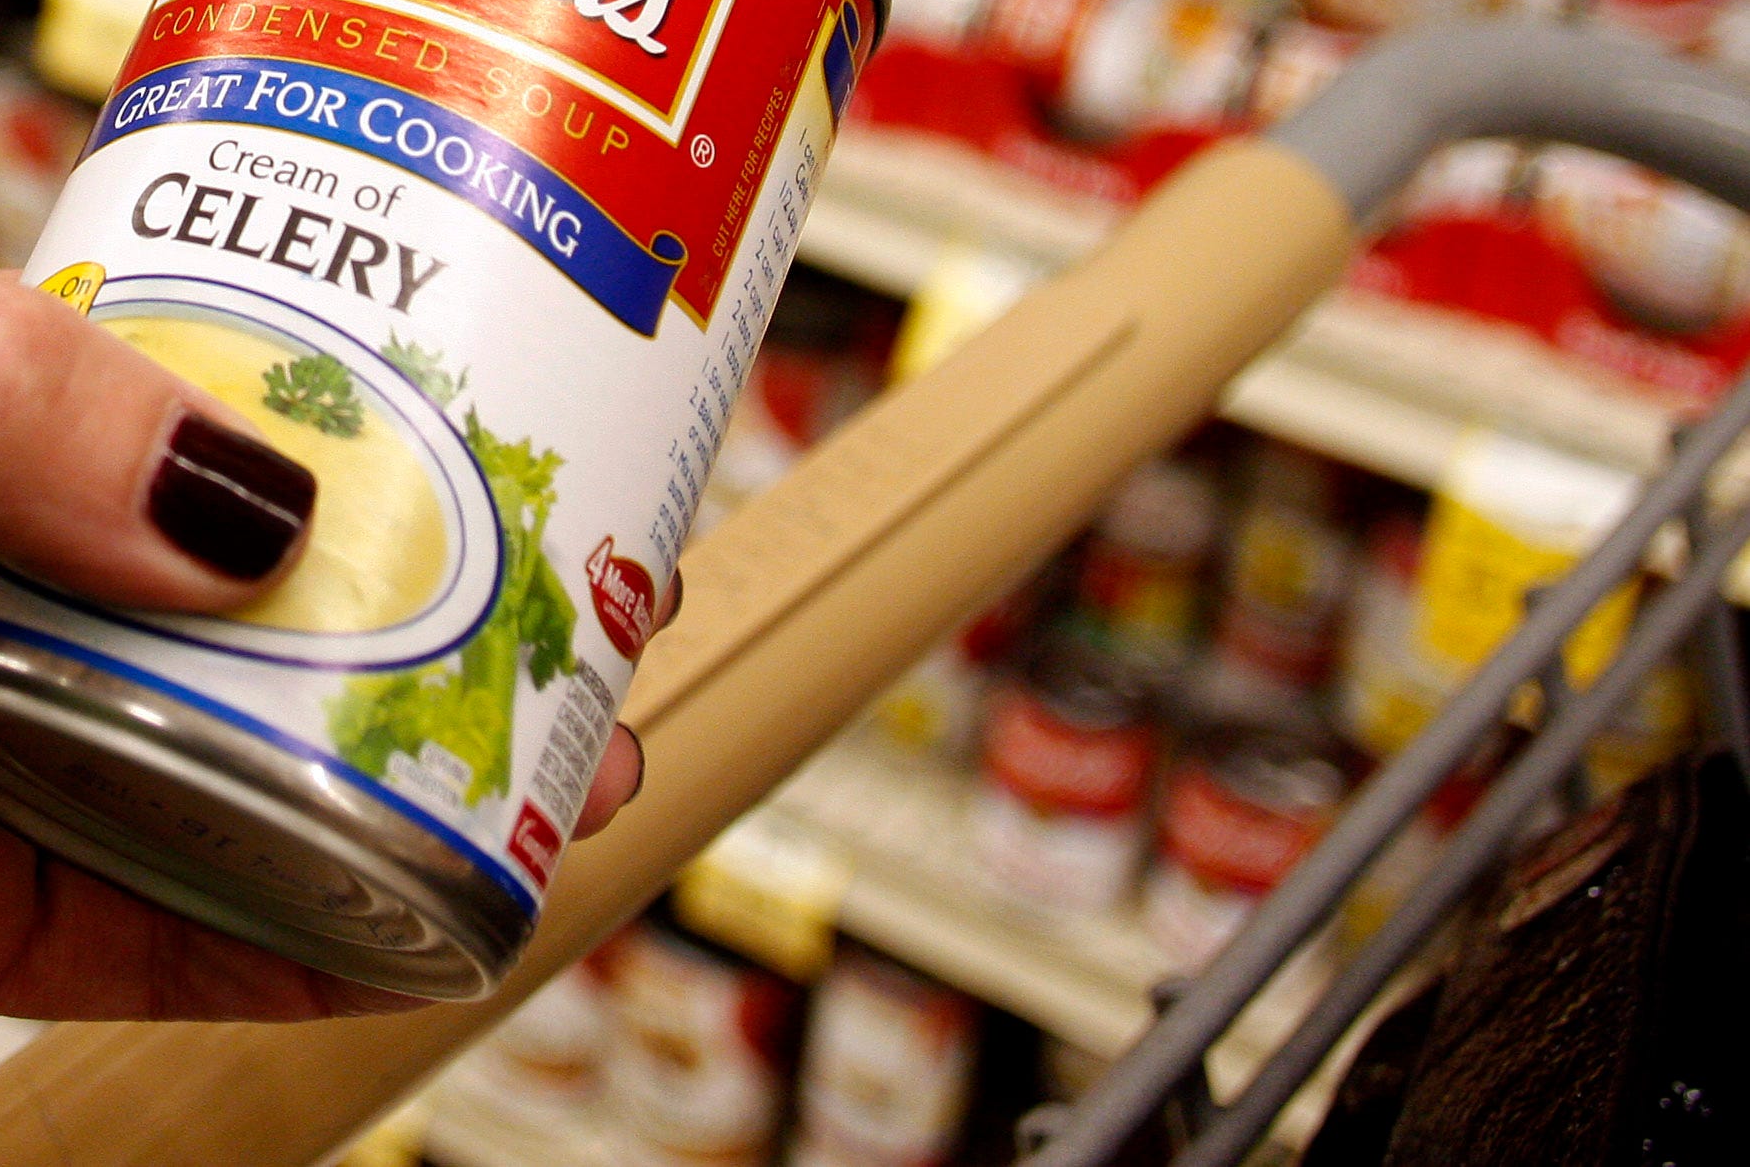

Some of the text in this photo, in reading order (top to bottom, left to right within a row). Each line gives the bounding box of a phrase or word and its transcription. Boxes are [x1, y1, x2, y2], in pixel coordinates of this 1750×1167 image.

[152, 3, 630, 155] CONDENSED SOUP
[114, 70, 582, 258] GREAT FOR COOKING
[209, 140, 407, 219] Cream of
[712, 85, 784, 258] CUT HERE FOR RECIPES
[60, 276, 92, 298] On
[132, 171, 449, 317] CELERY
